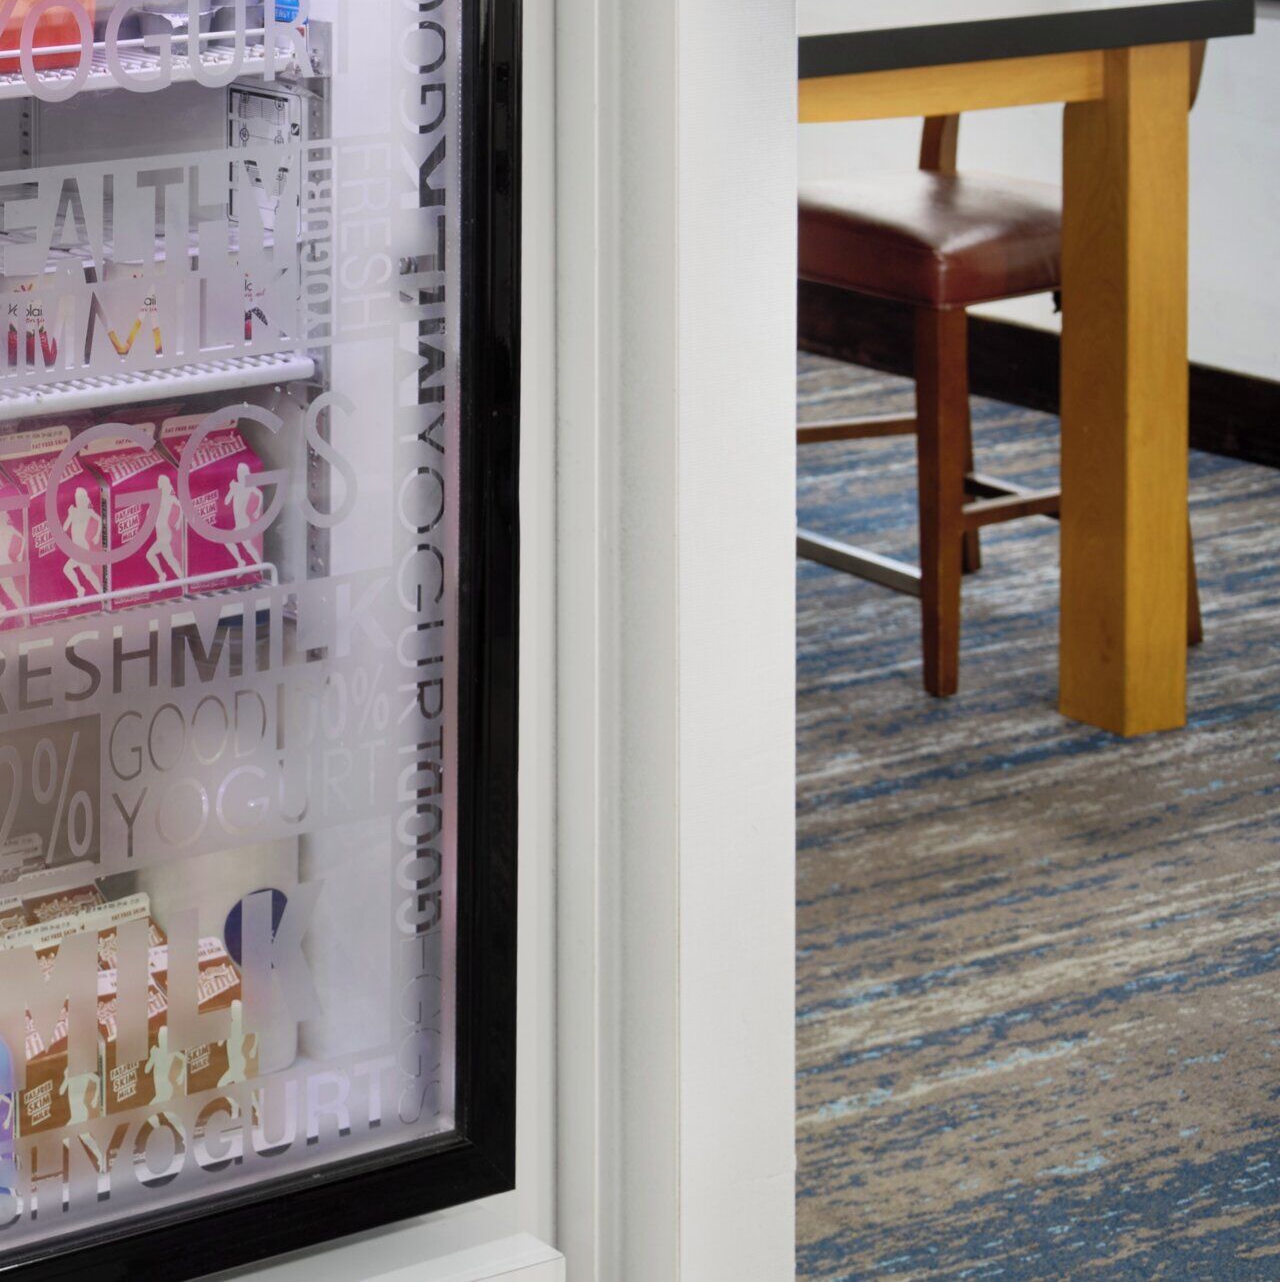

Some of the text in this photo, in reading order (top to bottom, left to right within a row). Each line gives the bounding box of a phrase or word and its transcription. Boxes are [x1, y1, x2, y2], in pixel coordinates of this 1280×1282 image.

[109, 688, 268, 782] GOOD
[112, 739, 386, 858] YOGURT
[78, 1053, 397, 1203] YOGURT
